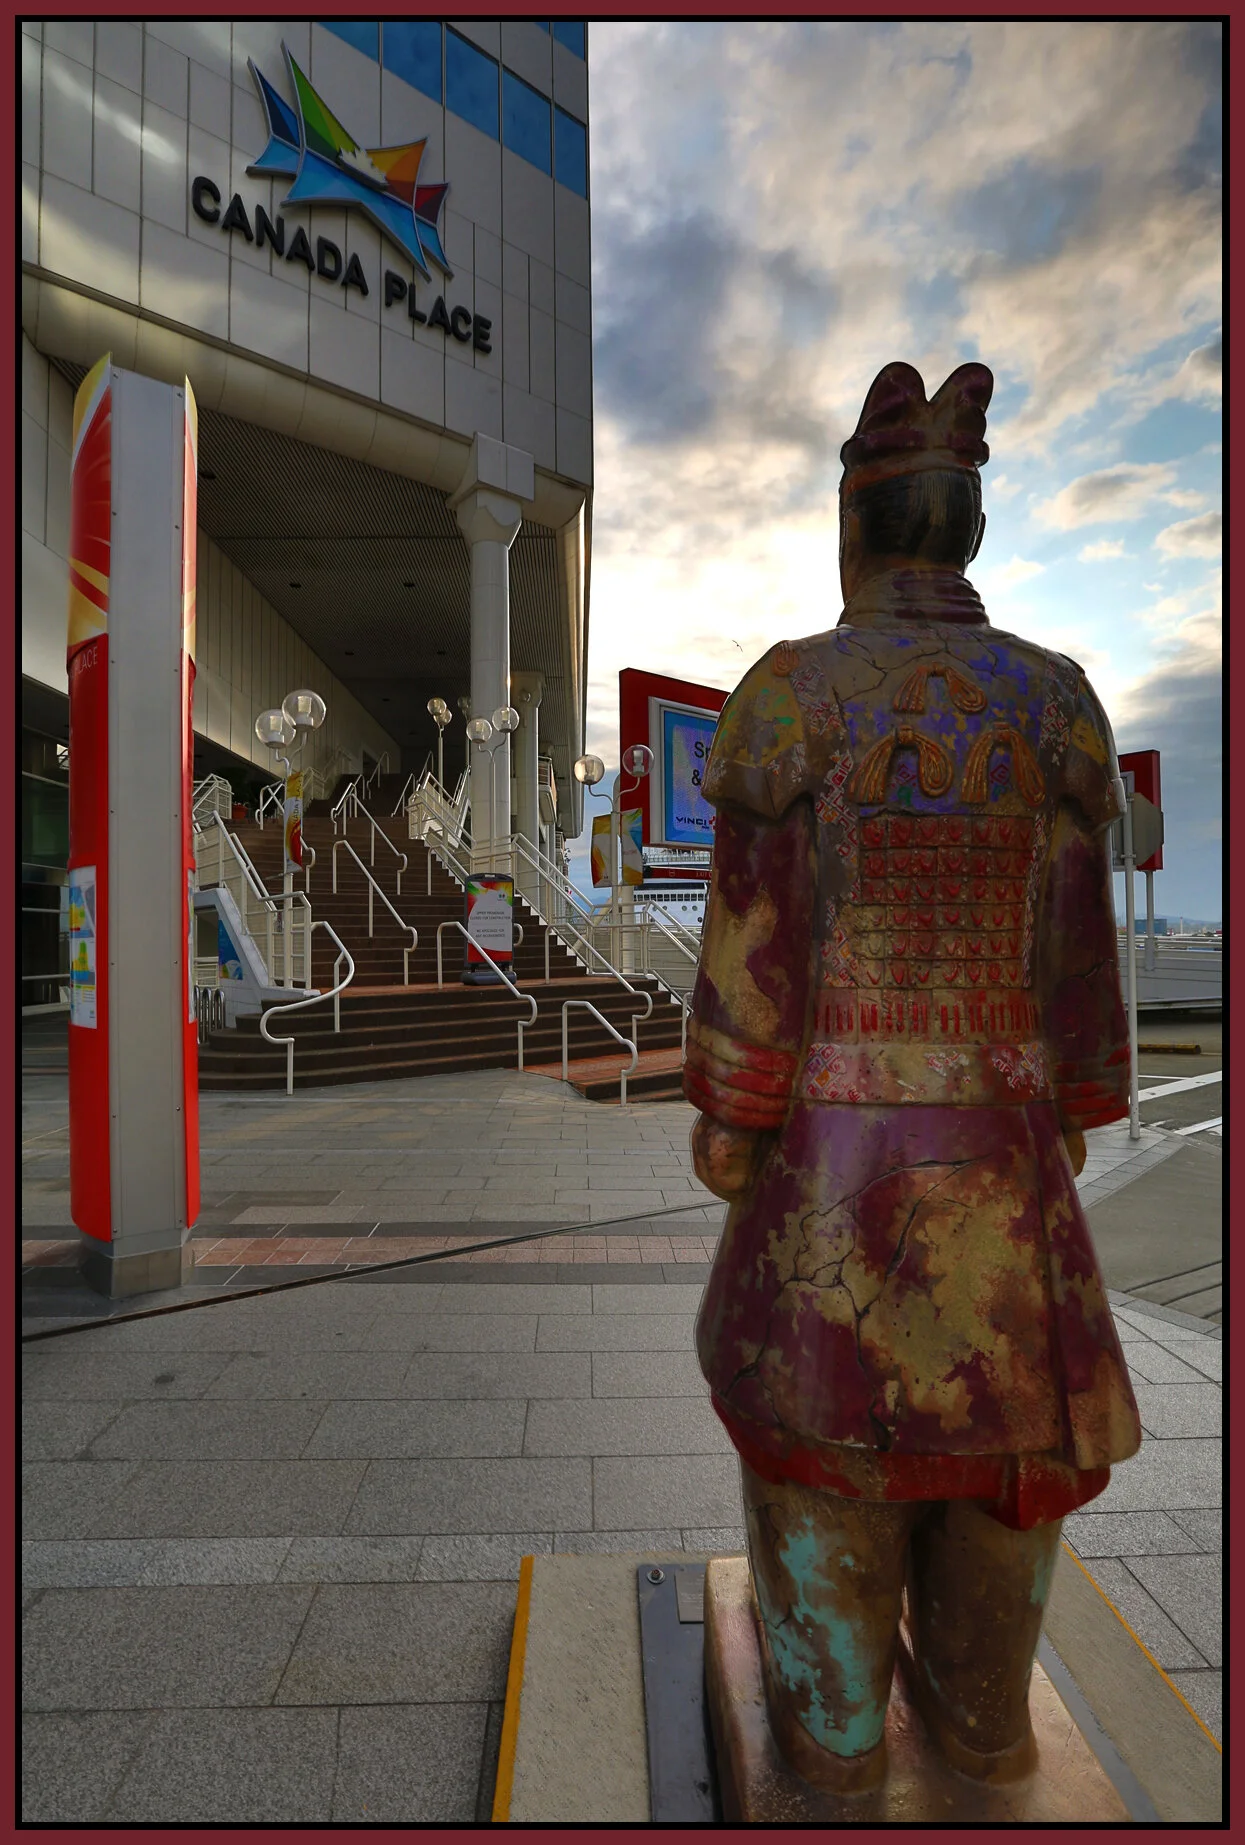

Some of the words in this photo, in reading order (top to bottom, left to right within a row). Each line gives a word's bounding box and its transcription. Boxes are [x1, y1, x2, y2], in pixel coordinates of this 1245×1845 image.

[192, 175, 369, 296] CANADA
[385, 269, 492, 354] PLACE
[691, 768, 703, 786] &
[676, 815, 707, 826] VINCI
